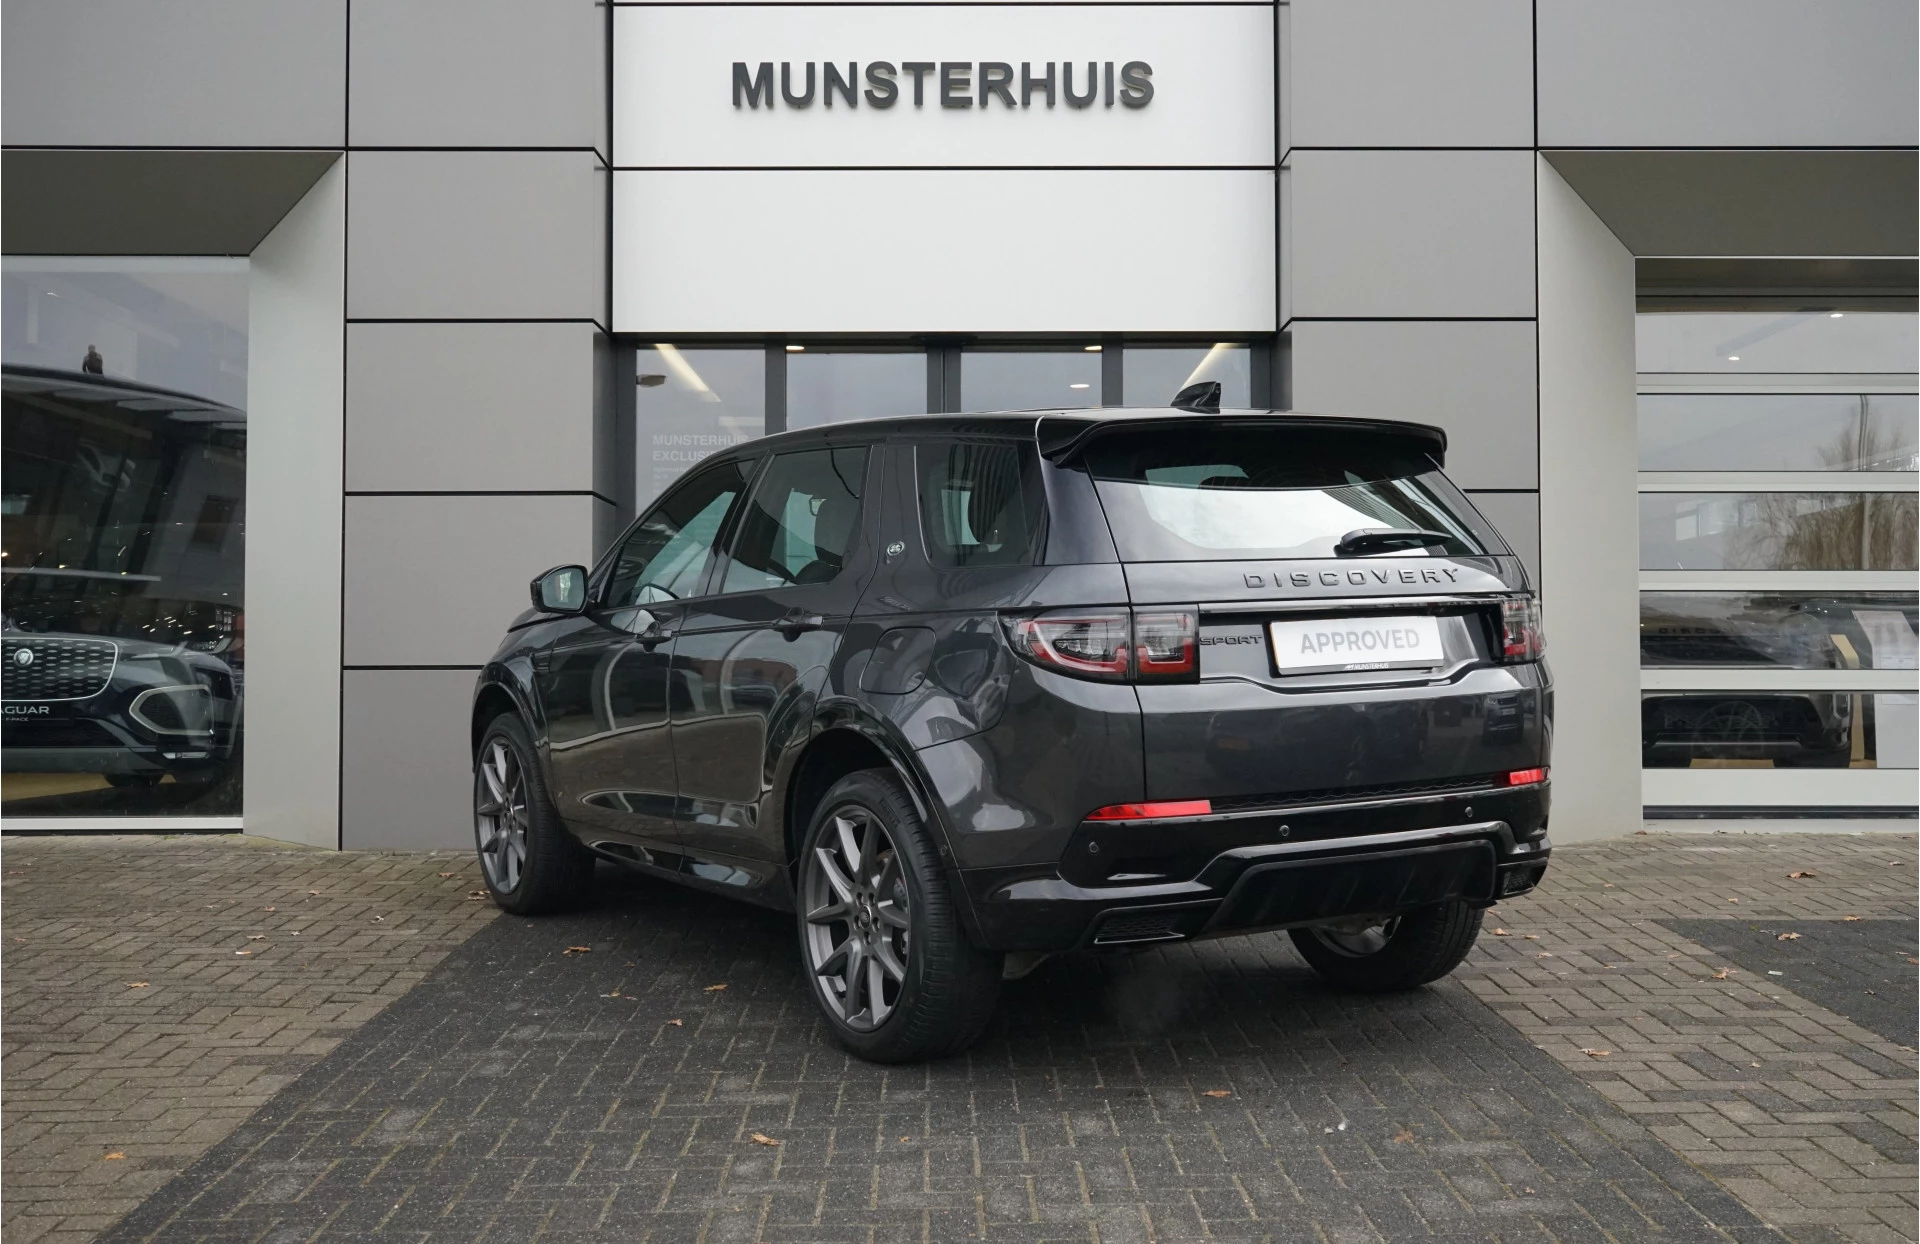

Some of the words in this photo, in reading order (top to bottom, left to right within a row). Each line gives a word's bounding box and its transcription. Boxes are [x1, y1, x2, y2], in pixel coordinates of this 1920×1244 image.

[732, 61, 1155, 109] MUNSTERHUIS
[1243, 568, 1459, 589] DISCOVERY
[1199, 634, 1263, 646] SPORT
[1300, 628, 1420, 654] APPROVED
